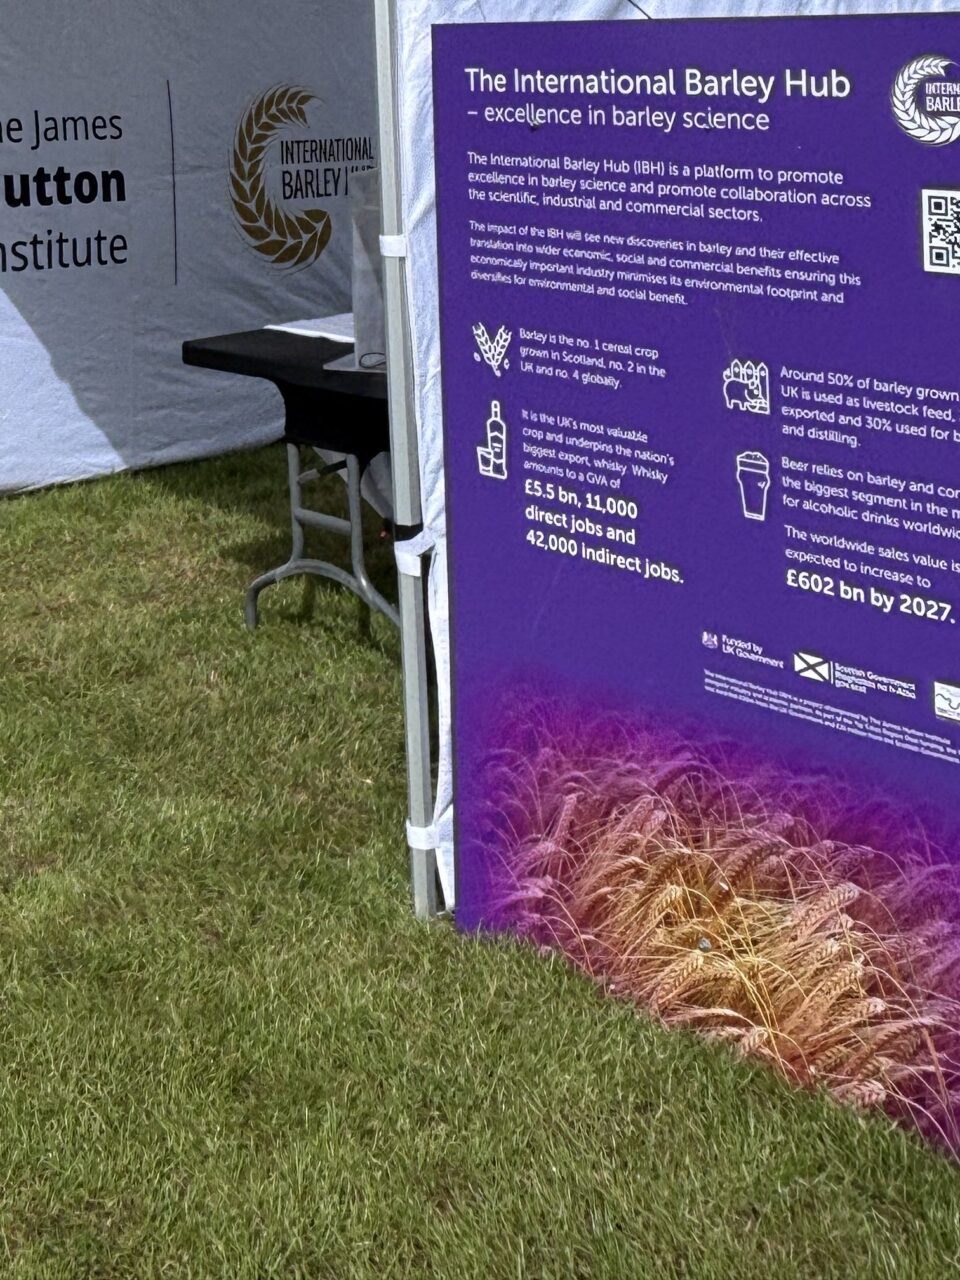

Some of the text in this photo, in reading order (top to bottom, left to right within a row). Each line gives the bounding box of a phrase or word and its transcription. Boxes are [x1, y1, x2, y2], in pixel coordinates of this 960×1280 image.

[464, 67, 850, 104] The International Barley Hub
[31, 109, 123, 151] James
[484, 102, 582, 126] excellence
[588, 104, 606, 125] in
[612, 104, 676, 133] barley
[682, 107, 770, 131] science
[280, 136, 375, 165] INTERNATIONAL
[466, 151, 843, 185] The International Barley Hub (IBH) is a platform to promote
[282, 168, 342, 200] BARLEY
[467, 171, 871, 208] excellence in barley science and promote collaboration across
[468, 188, 486, 200] the
[542, 192, 596, 209] industrial
[598, 197, 622, 211] and
[625, 200, 704, 218] commercial
[708, 206, 762, 222] sectors.
[780, 365, 824, 383] Around
[827, 372, 854, 387] 50%
[856, 377, 870, 389] of
[873, 378, 913, 398] barley
[780, 384, 798, 398] UK
[801, 387, 811, 401] is
[813, 391, 843, 405] used
[845, 396, 860, 408] as
[862, 396, 919, 416] livestock
[781, 405, 835, 423] exported
[838, 414, 862, 427] and
[865, 415, 892, 432] 30%
[895, 423, 927, 437] used
[930, 425, 950, 440] for
[781, 424, 861, 448] and distilling.
[781, 456, 934, 495] Beer relies on barley and
[524, 478, 638, 519] £5.5 bn, 11,000
[781, 475, 948, 517] the biggest segment in the
[782, 493, 800, 508] for
[802, 499, 858, 520] alcoholic
[861, 510, 900, 528] drinks
[524, 504, 636, 545] direct jobs and
[526, 529, 684, 583] 42,000 indirect jobs.
[783, 524, 808, 541] The
[809, 533, 875, 555] worldwide
[878, 546, 910, 562] sales
[912, 553, 948, 570] value
[784, 548, 931, 588] expected to increase to
[786, 568, 955, 624] £602 bn by 2027.
